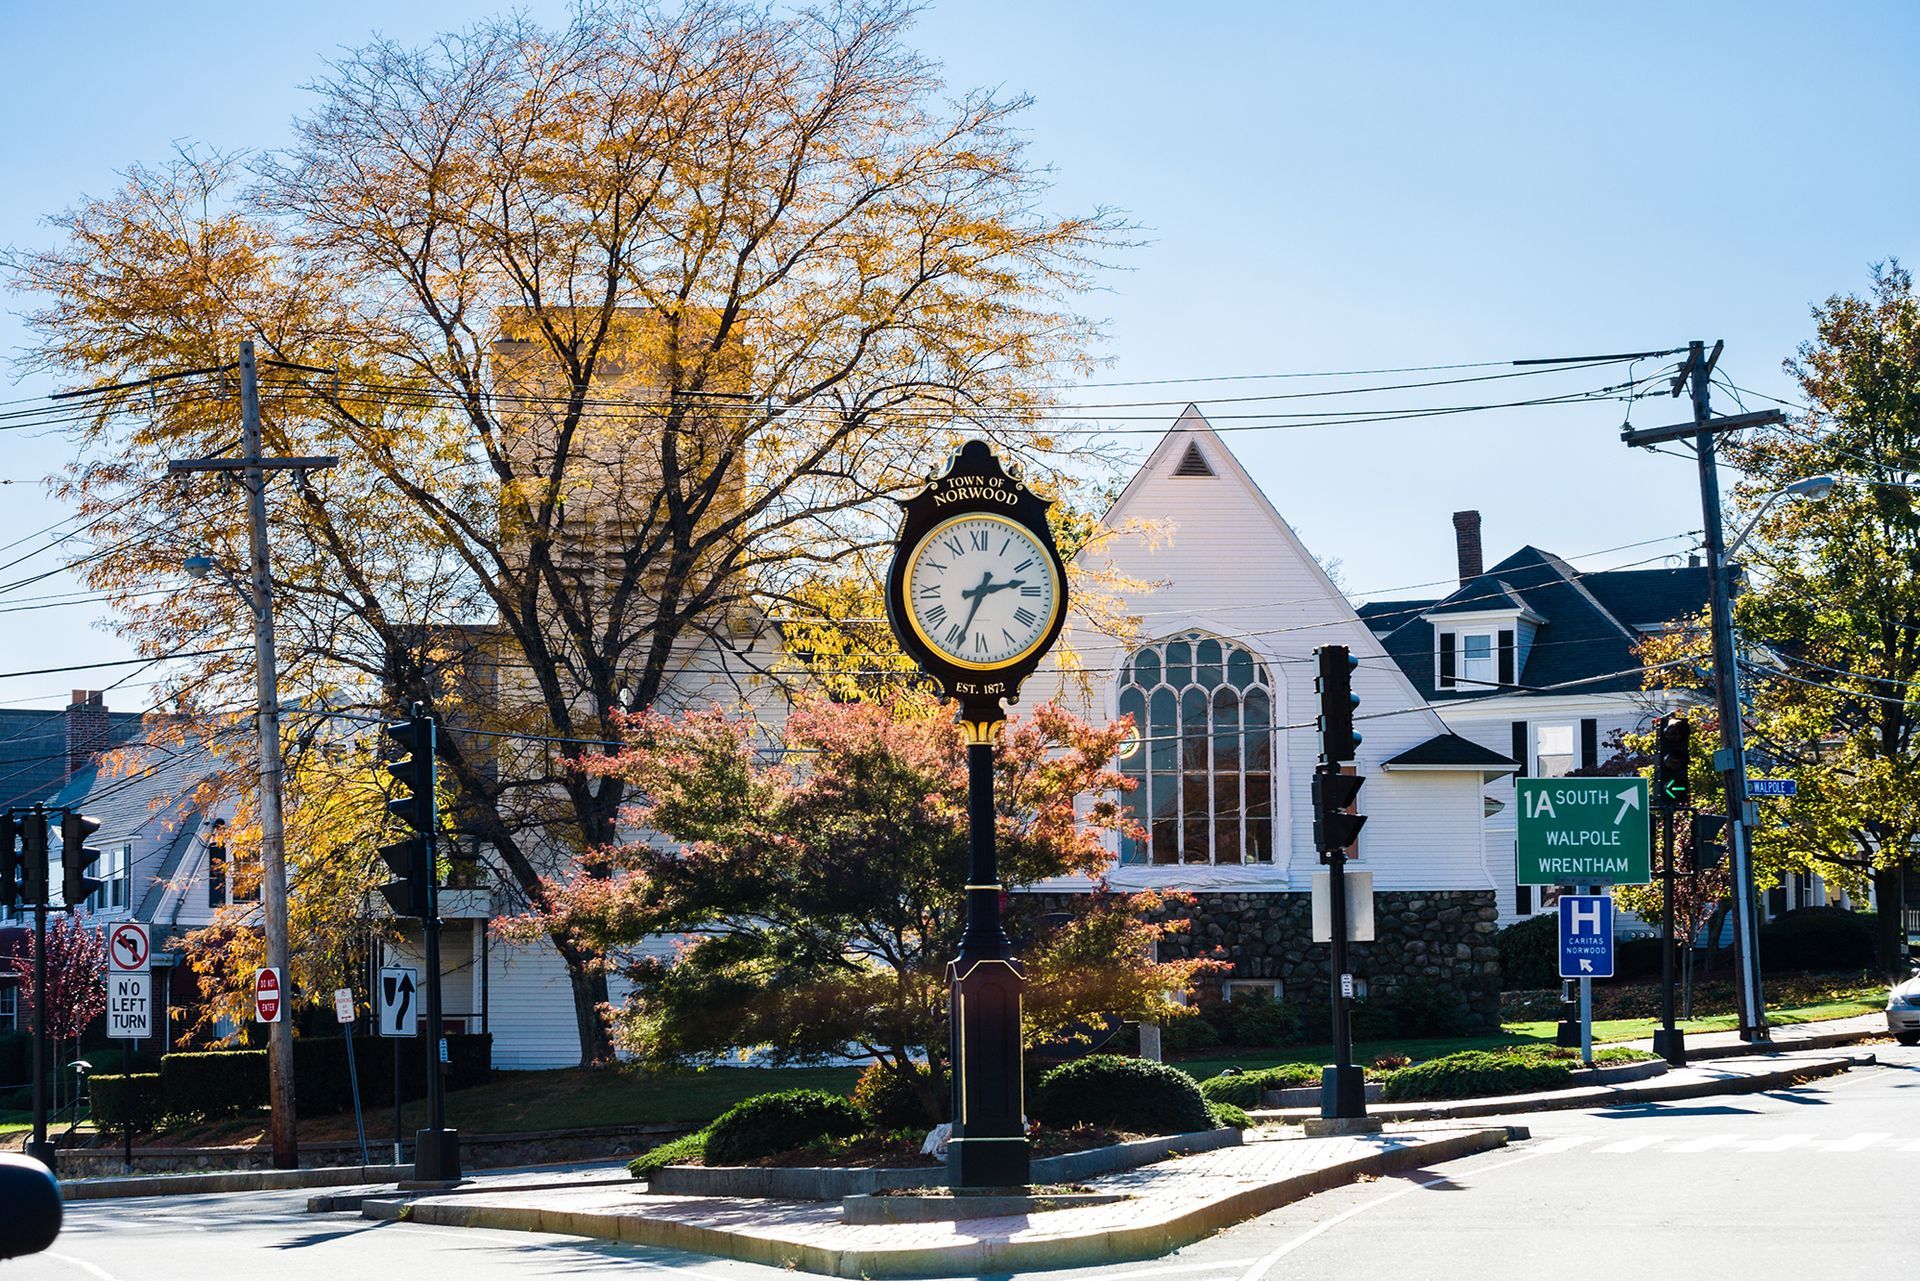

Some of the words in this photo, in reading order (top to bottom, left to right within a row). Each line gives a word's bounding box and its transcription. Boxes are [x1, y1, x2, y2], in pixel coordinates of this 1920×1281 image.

[947, 475, 985, 488] TOWN
[989, 477, 1005, 488] OF
[933, 487, 1018, 507] NORWOOD
[970, 530, 988, 551] XII
[955, 682, 979, 695] EST.
[984, 682, 1006, 695] 1872
[1753, 781, 1786, 793] WALPOLE
[1523, 790, 1557, 819] 1A
[1556, 790, 1609, 805] SOUTH
[1546, 831, 1621, 846] WALPOLE
[1538, 857, 1629, 873] WRENTHAM
[1571, 900, 1601, 935] H
[1568, 937, 1604, 945] CARITAS
[1566, 946, 1607, 955] NORWOOD
[118, 981, 140, 996] NO
[260, 980, 267, 988] DO
[267, 979, 276, 988] NOT
[112, 998, 147, 1012] LEFT
[261, 1003, 275, 1012] ENTER
[112, 1014, 147, 1029] TURN
